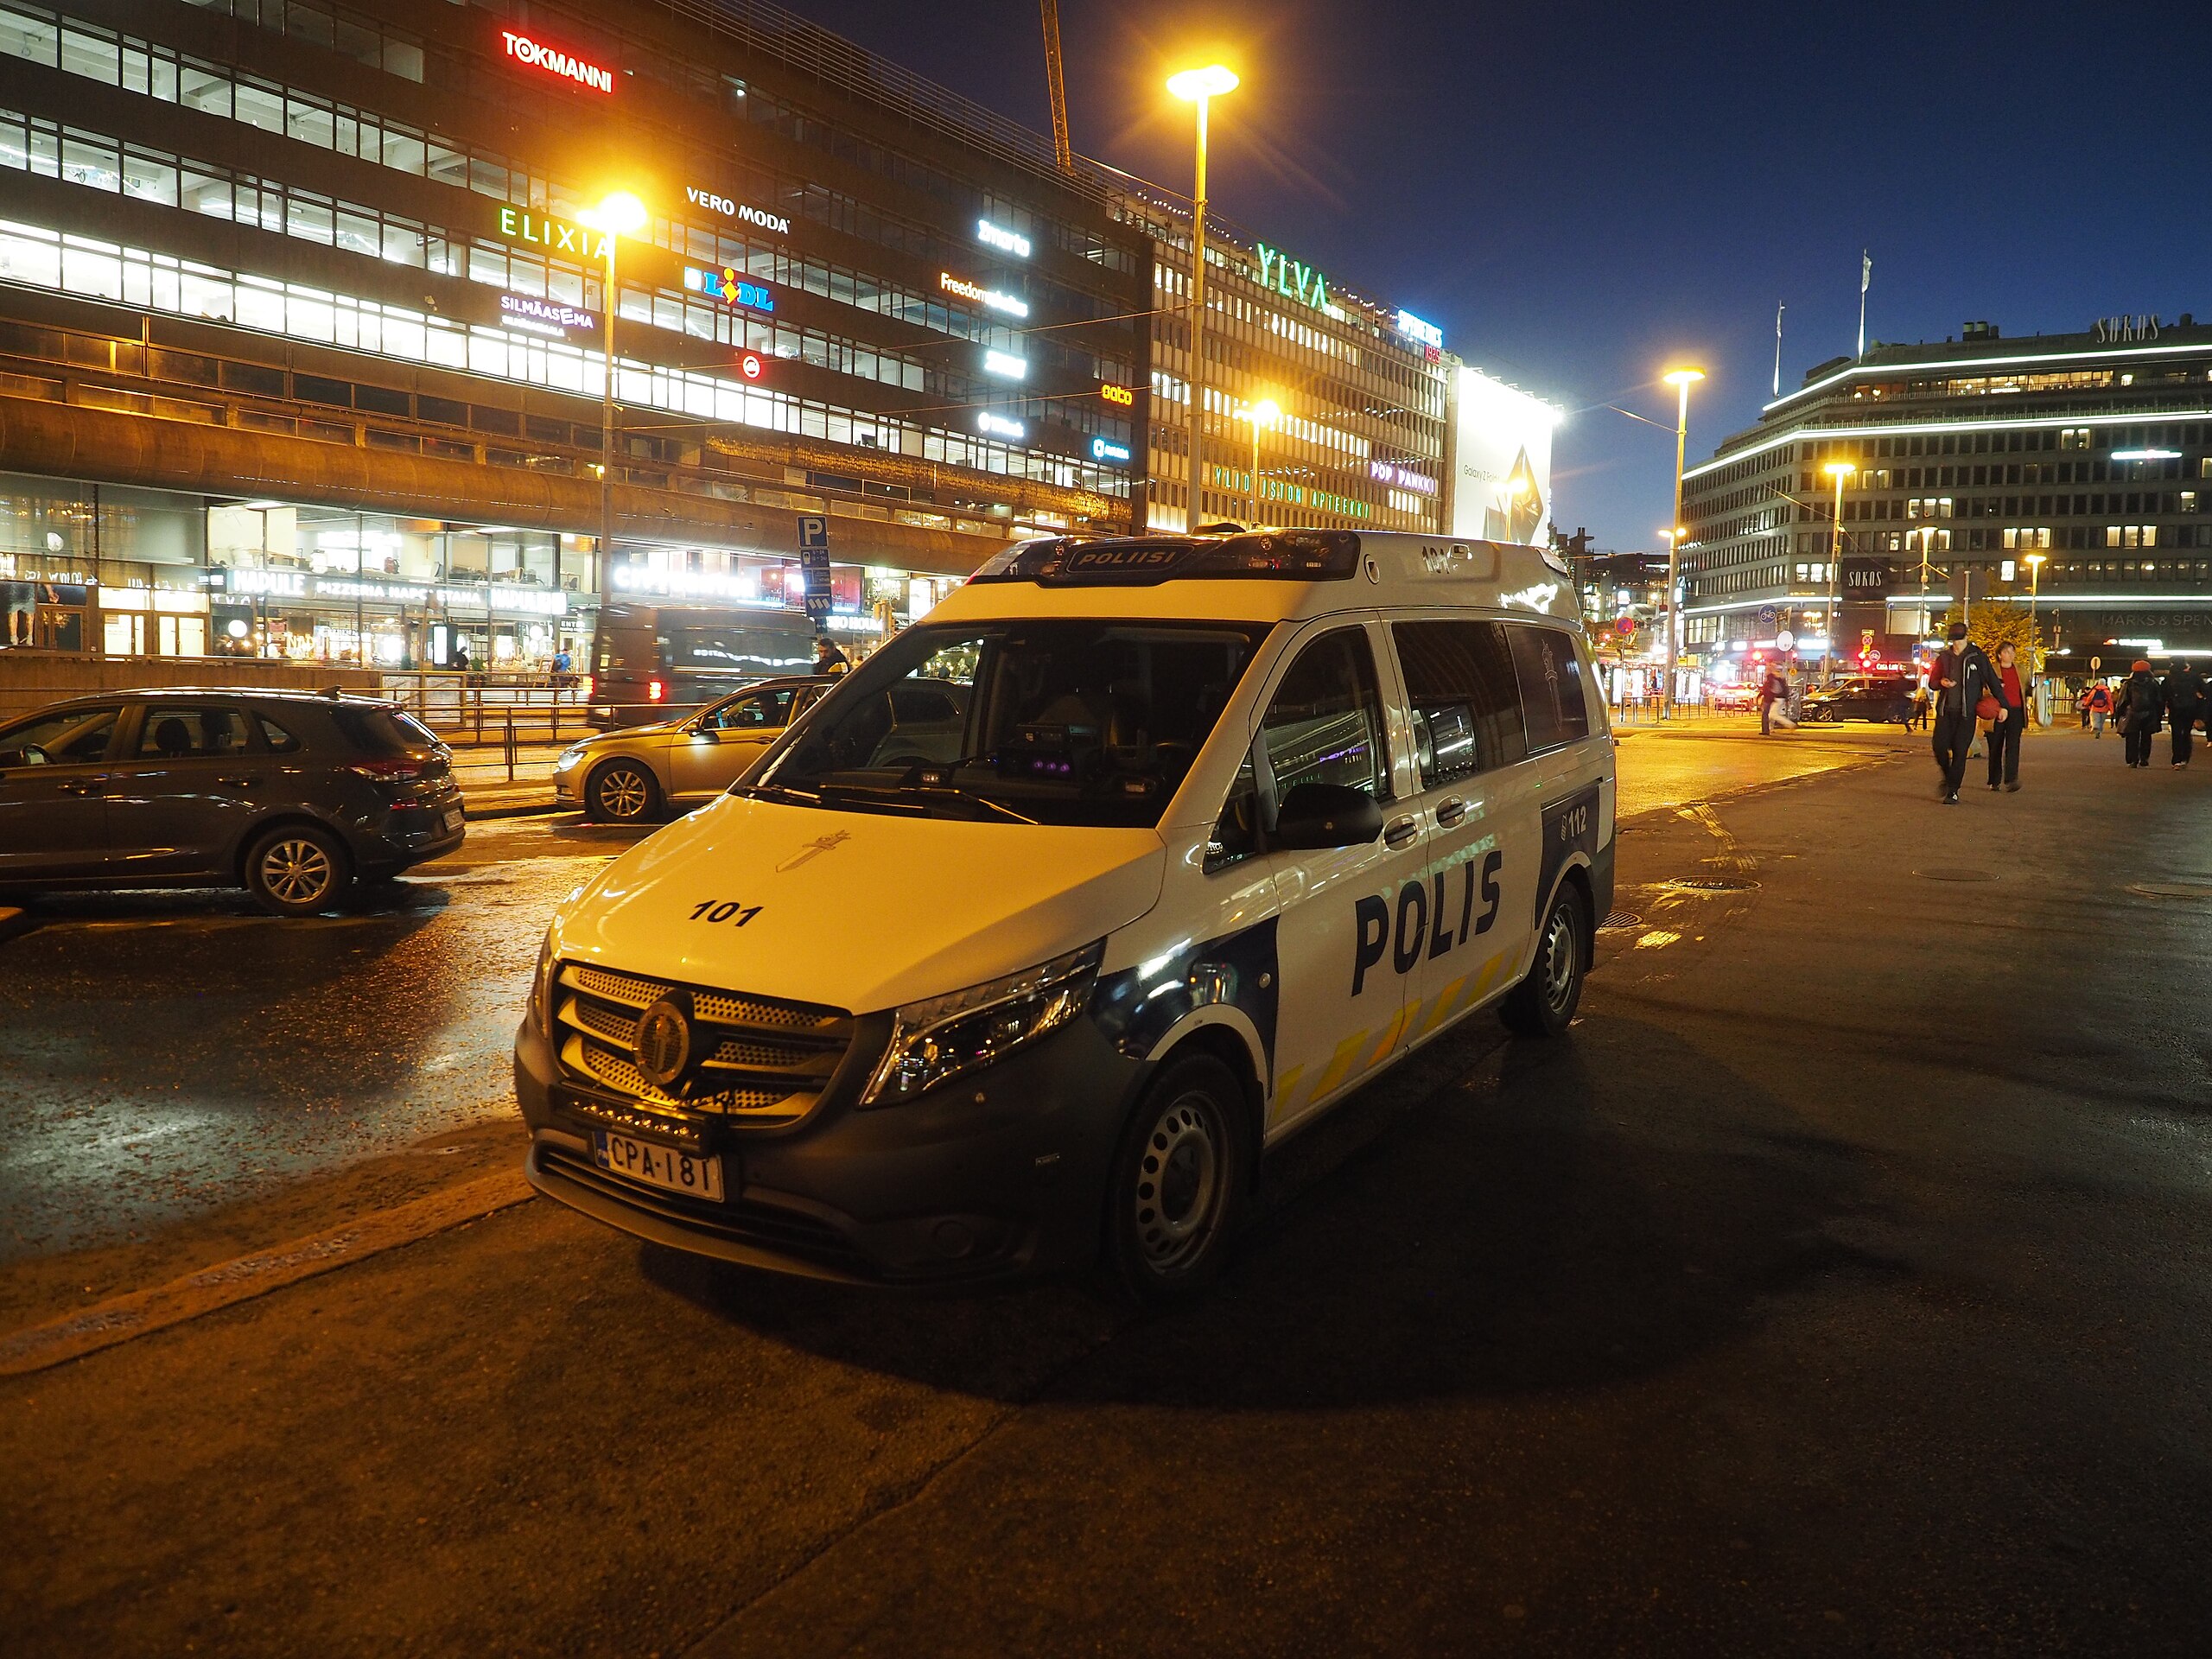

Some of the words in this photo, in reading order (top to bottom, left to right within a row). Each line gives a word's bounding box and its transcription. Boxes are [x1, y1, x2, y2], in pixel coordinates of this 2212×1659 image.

[502, 31, 612, 93] TOKMANNI
[686, 186, 735, 216] VERO
[738, 205, 789, 234] MODA
[500, 207, 610, 259] ELIXIA
[1257, 243, 1327, 313] YLVA
[500, 296, 594, 329] SILMÄASEMA
[2096, 314, 2158, 344] SOKOS
[1215, 467, 1303, 504] YLIOISTON
[1312, 491, 1370, 518] APTEEKKI
[1370, 461, 1393, 480] POP
[1397, 468, 1435, 493] PANKKI
[1077, 551, 1176, 566] POLIISI
[233, 570, 306, 596] NAPULE
[316, 582, 385, 598] PIZZERIA
[1848, 570, 1882, 587] SOKOS
[2101, 614, 2156, 626] MARKS
[1568, 805, 1586, 837] 112
[689, 899, 764, 928] 101
[1351, 849, 1503, 997] POLIS
[611, 1136, 710, 1191] CPA-181
